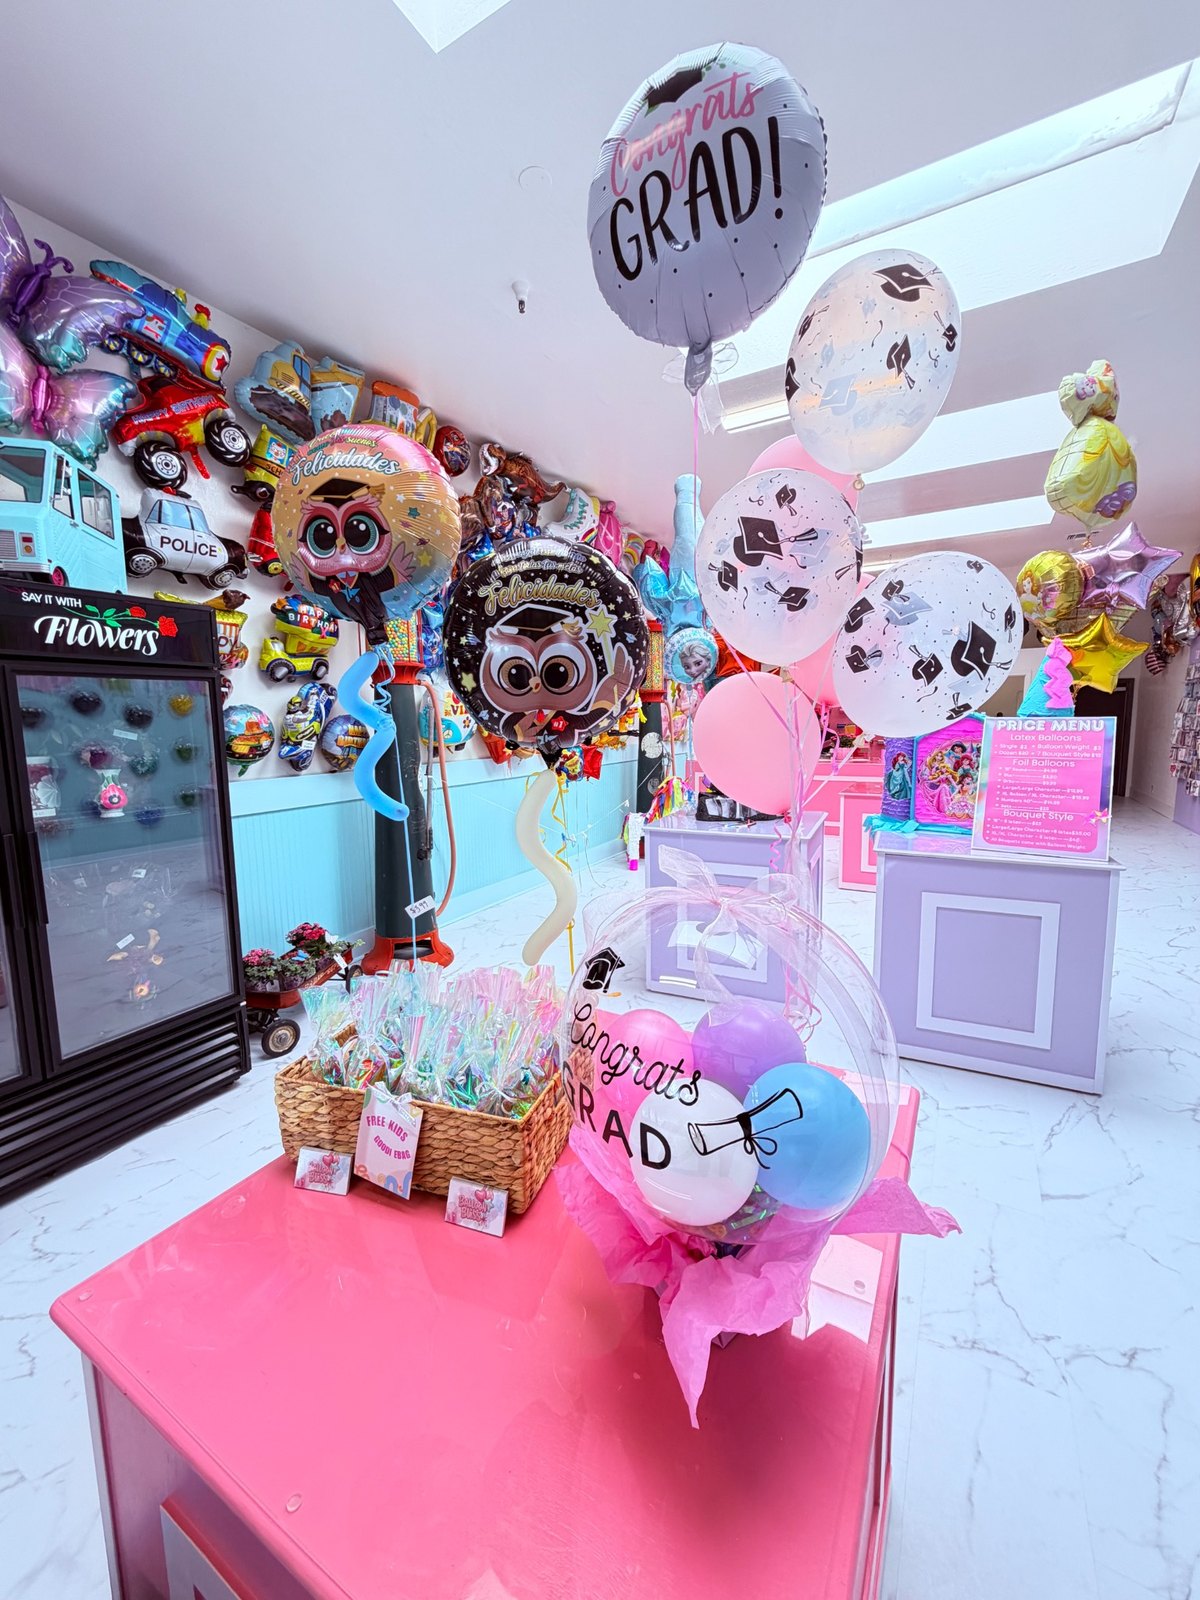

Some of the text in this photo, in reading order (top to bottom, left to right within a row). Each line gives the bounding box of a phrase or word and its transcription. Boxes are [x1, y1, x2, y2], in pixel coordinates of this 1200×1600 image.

[610, 71, 764, 197] Congrats
[610, 116, 783, 281] GRAD!
[131, 408, 168, 425] HAPPY
[290, 448, 402, 486] Felicidades
[160, 536, 217, 558] POLICE
[21, 592, 82, 608] SAY IT WITH
[478, 574, 602, 616] Felicidades
[33, 615, 160, 656] Flowers
[996, 720, 1104, 731] PRICE MENU
[1038, 734, 1082, 742] Balloons
[1012, 759, 1076, 768] Foil Balloons
[1003, 809, 1074, 822] Bouquet Style
[571, 1000, 702, 1107] Congrats
[562, 1060, 672, 1171] GRAD
[366, 1115, 409, 1142] FREE KIDS
[393, 1150, 412, 1160] EBAG
